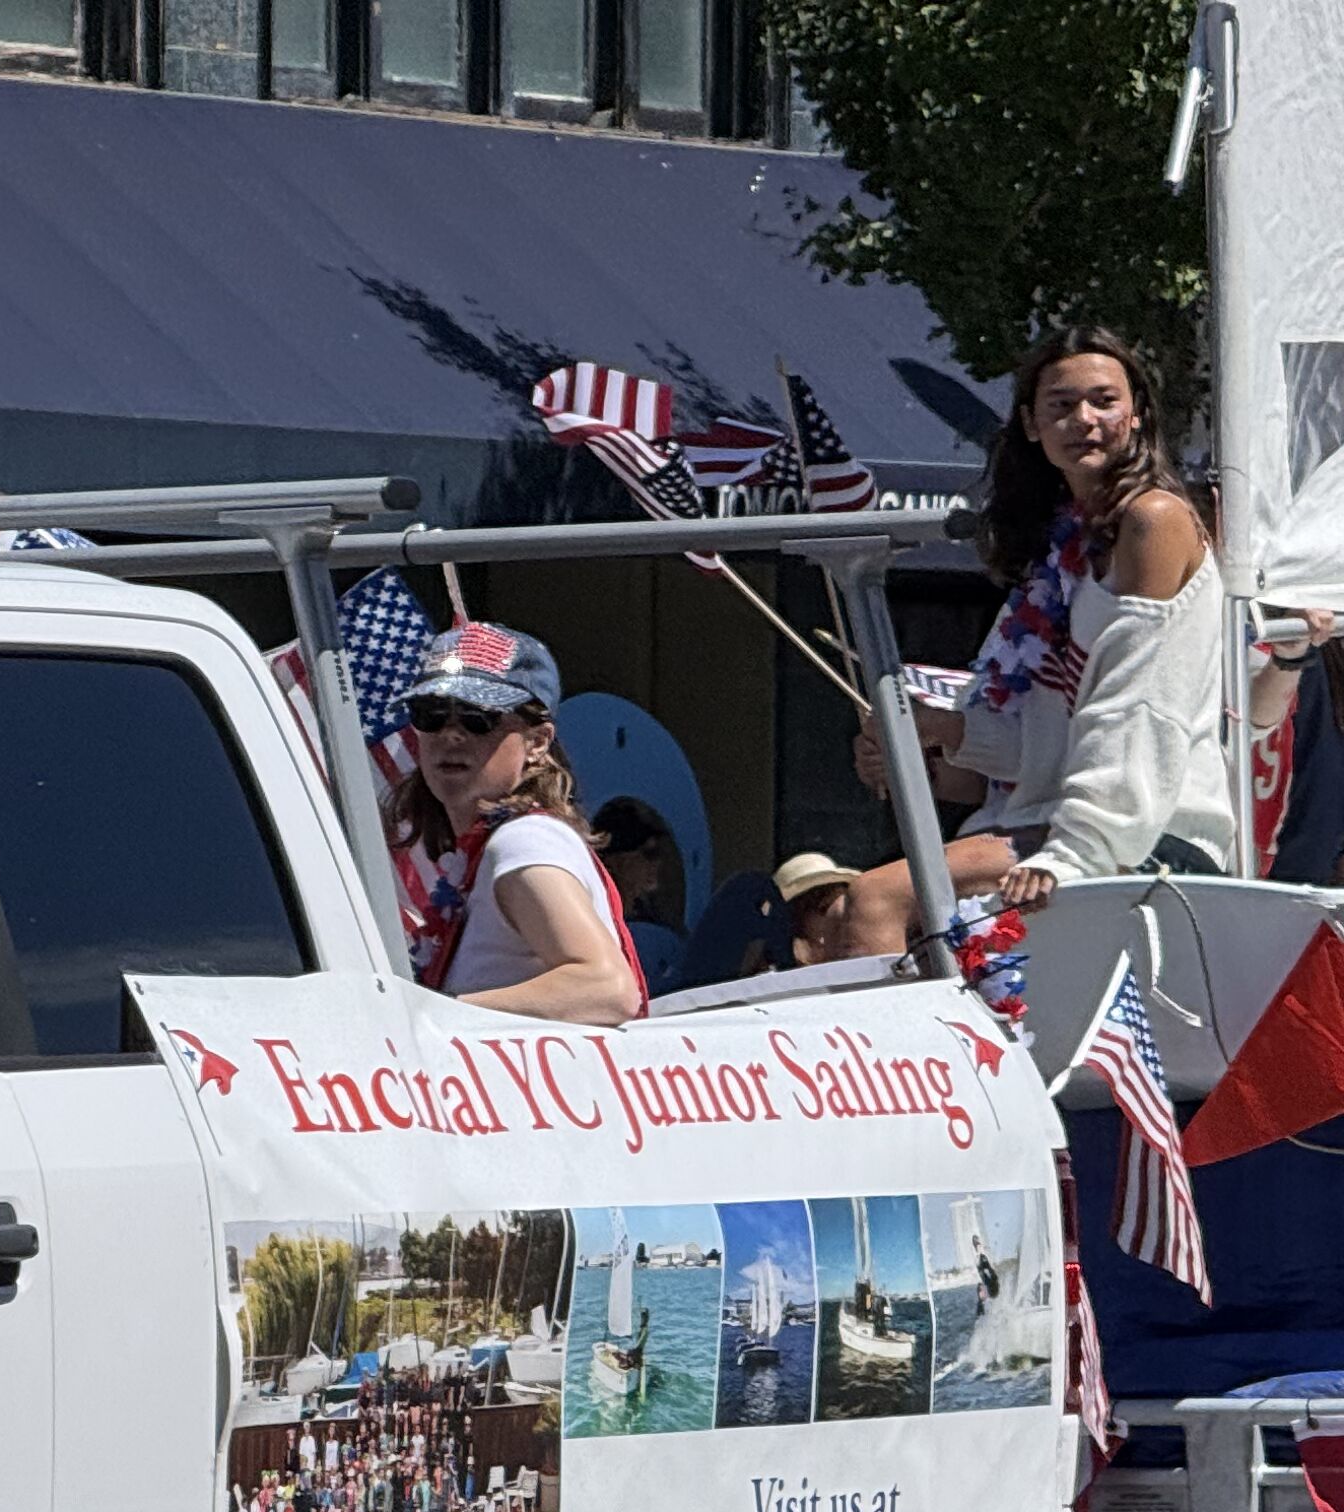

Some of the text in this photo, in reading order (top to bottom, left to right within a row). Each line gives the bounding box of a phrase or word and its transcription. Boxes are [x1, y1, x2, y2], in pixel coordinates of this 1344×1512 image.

[479, 1034, 603, 1131] YC
[586, 1030, 782, 1155] Junior
[767, 1026, 975, 1150] Sailing
